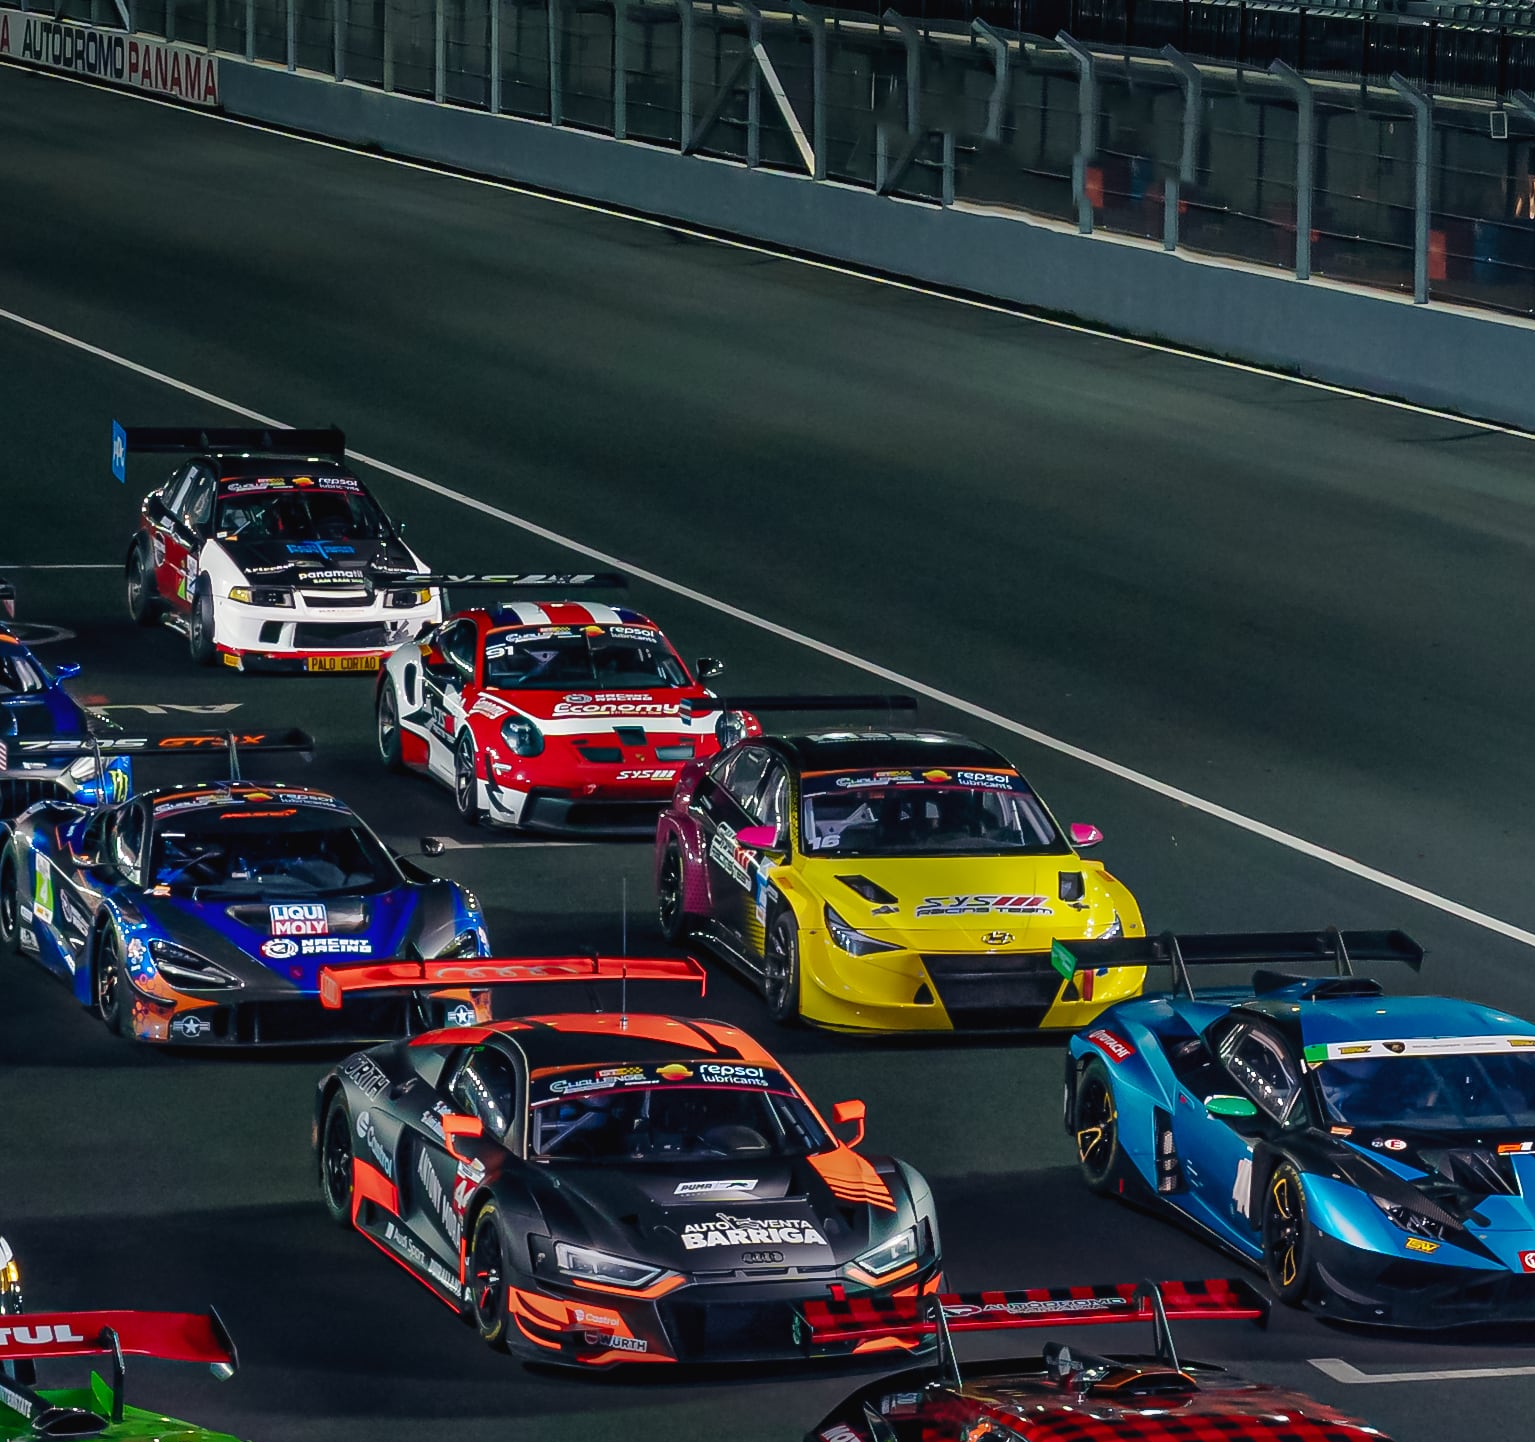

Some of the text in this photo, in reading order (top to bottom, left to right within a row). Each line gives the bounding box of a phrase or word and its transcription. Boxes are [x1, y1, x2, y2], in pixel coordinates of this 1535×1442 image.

[22, 28, 218, 101] AUTODROMO PANAMA
[609, 625, 655, 637] repsol
[486, 646, 514, 659] 91
[311, 657, 336, 670] PALO
[553, 702, 680, 714] Economy
[956, 771, 1010, 784] repsol
[273, 906, 324, 920] LIQUI
[275, 920, 325, 935] MOLY
[699, 1063, 764, 1078] repsol
[701, 1074, 769, 1087] lubricants
[680, 1182, 713, 1192] PUMA
[684, 1219, 813, 1233] AUTO VENTA
[680, 1228, 828, 1250] BARRIGA
